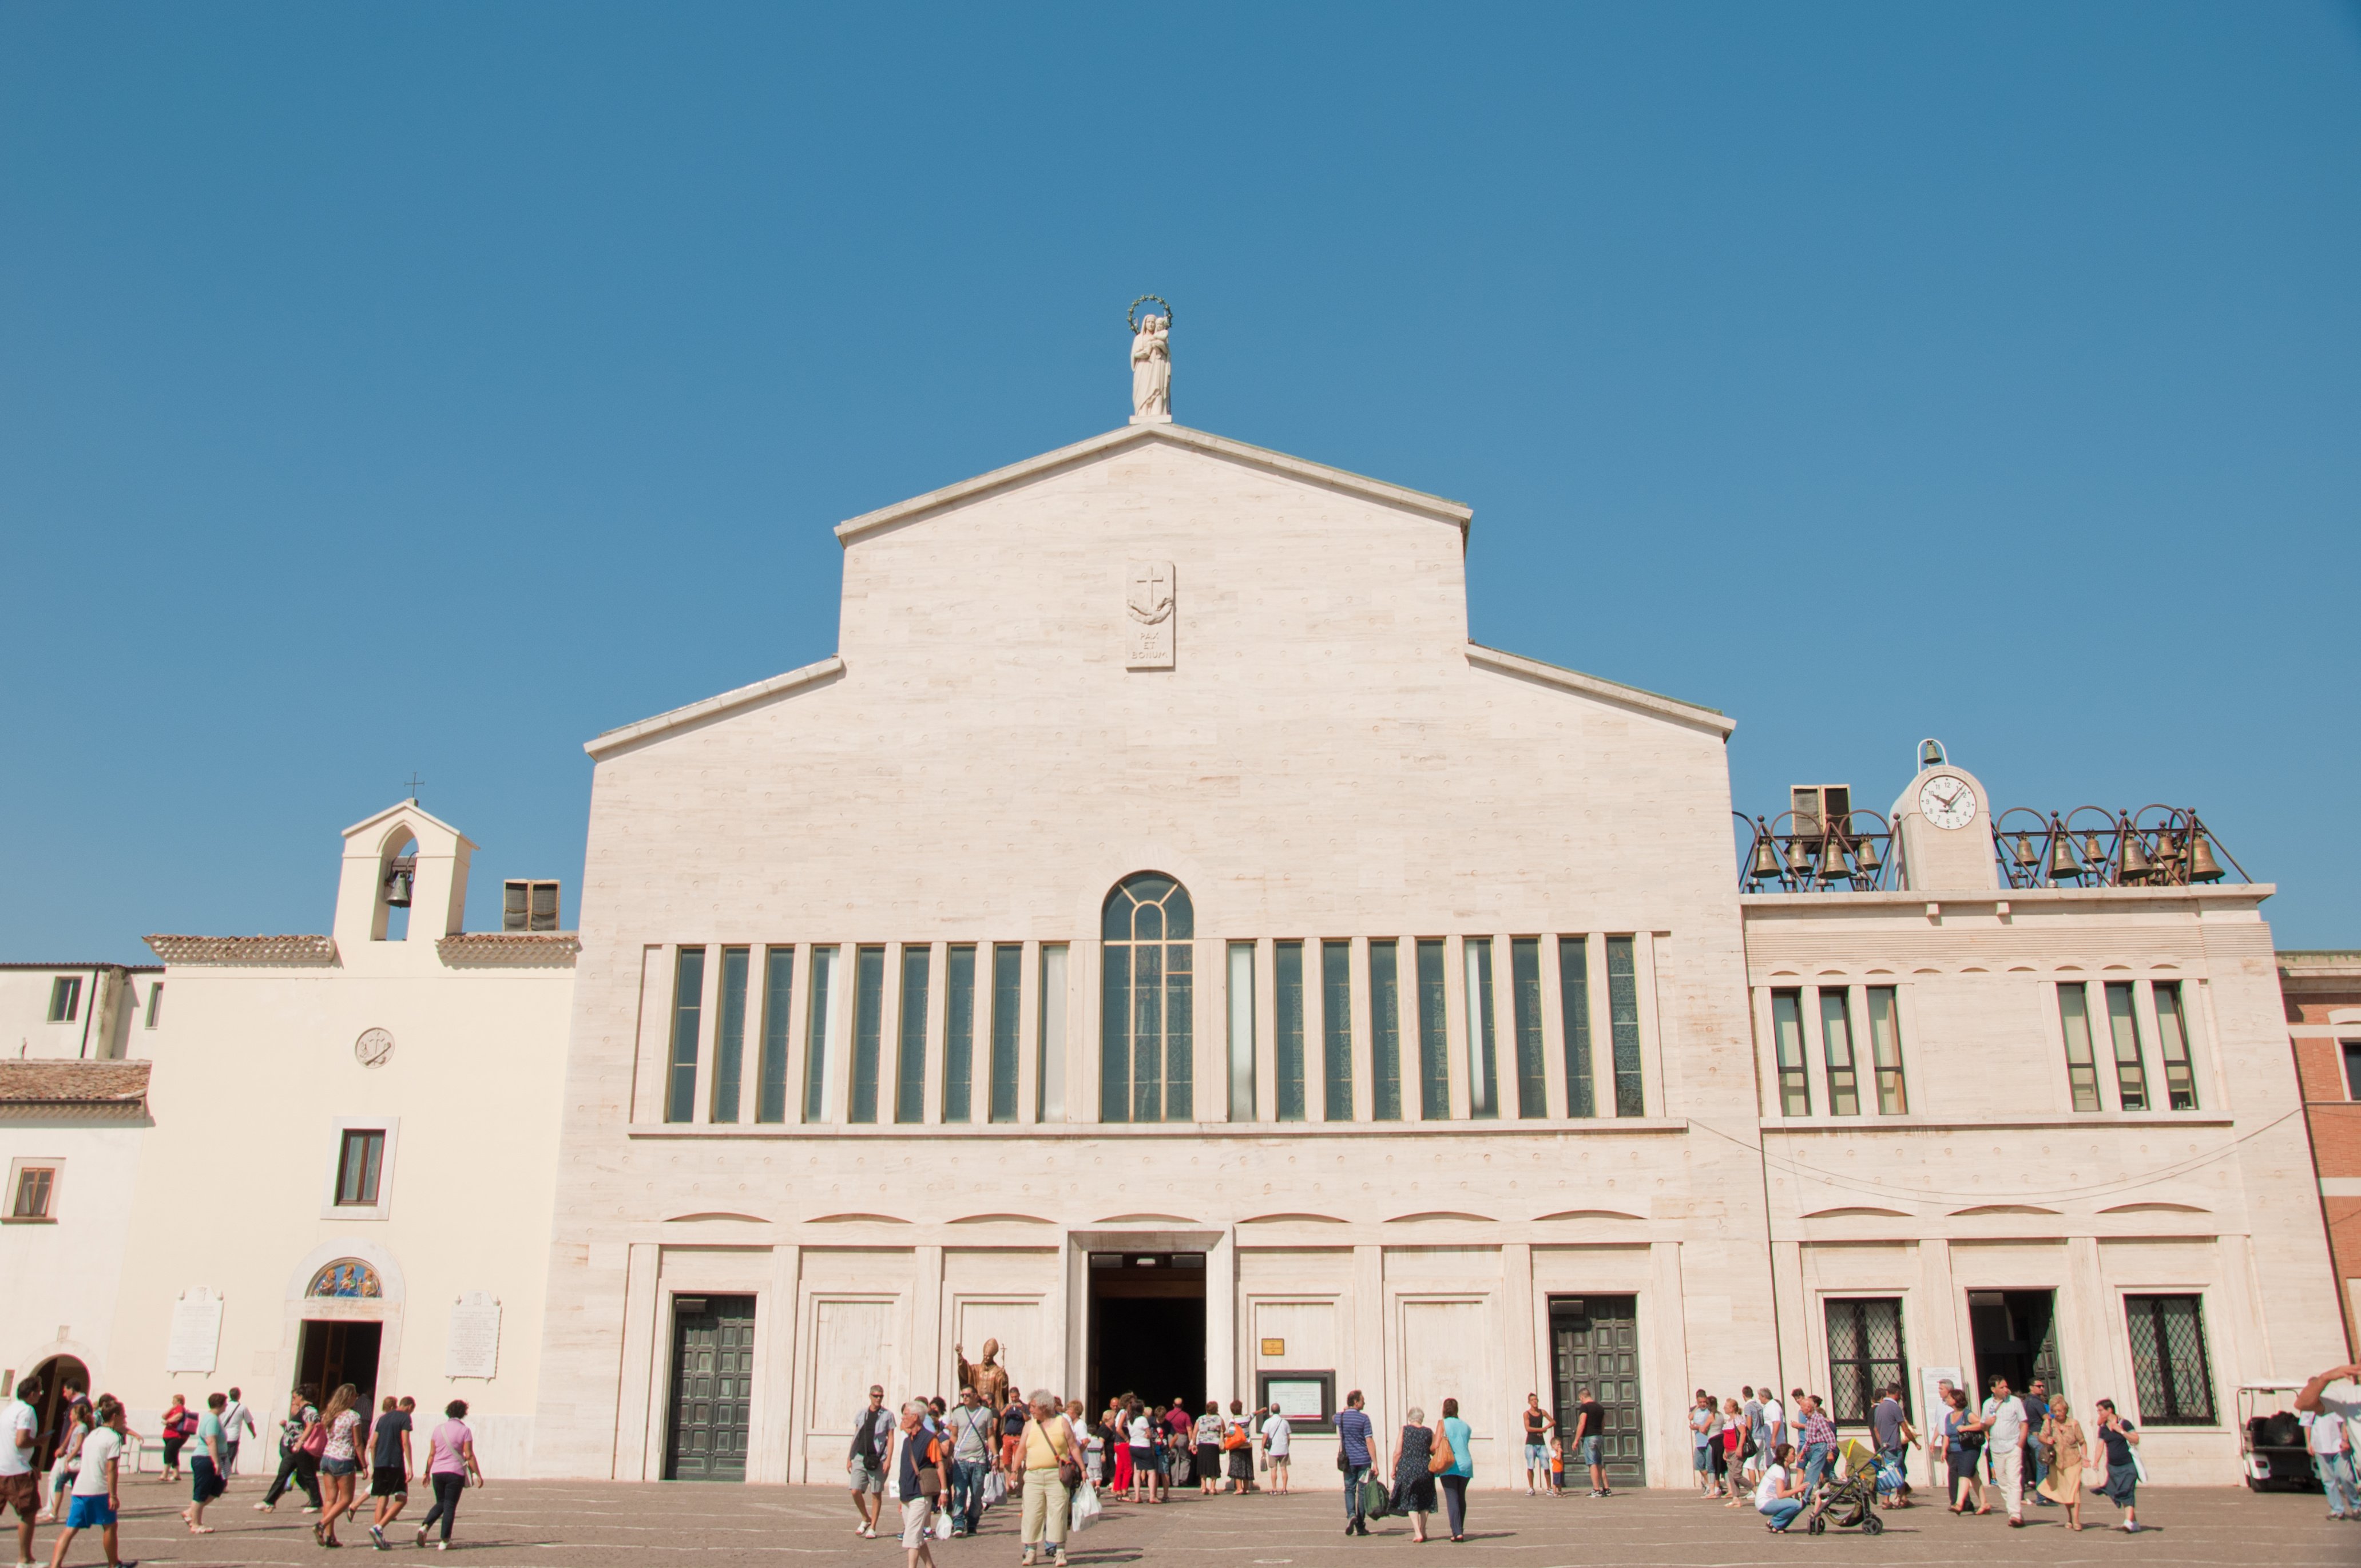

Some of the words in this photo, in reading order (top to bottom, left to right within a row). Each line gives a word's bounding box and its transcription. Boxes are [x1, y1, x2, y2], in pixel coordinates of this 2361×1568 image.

[1140, 632, 1159, 640] PAX
[1144, 641, 1156, 649] ET
[1132, 651, 1168, 660] BONUM
